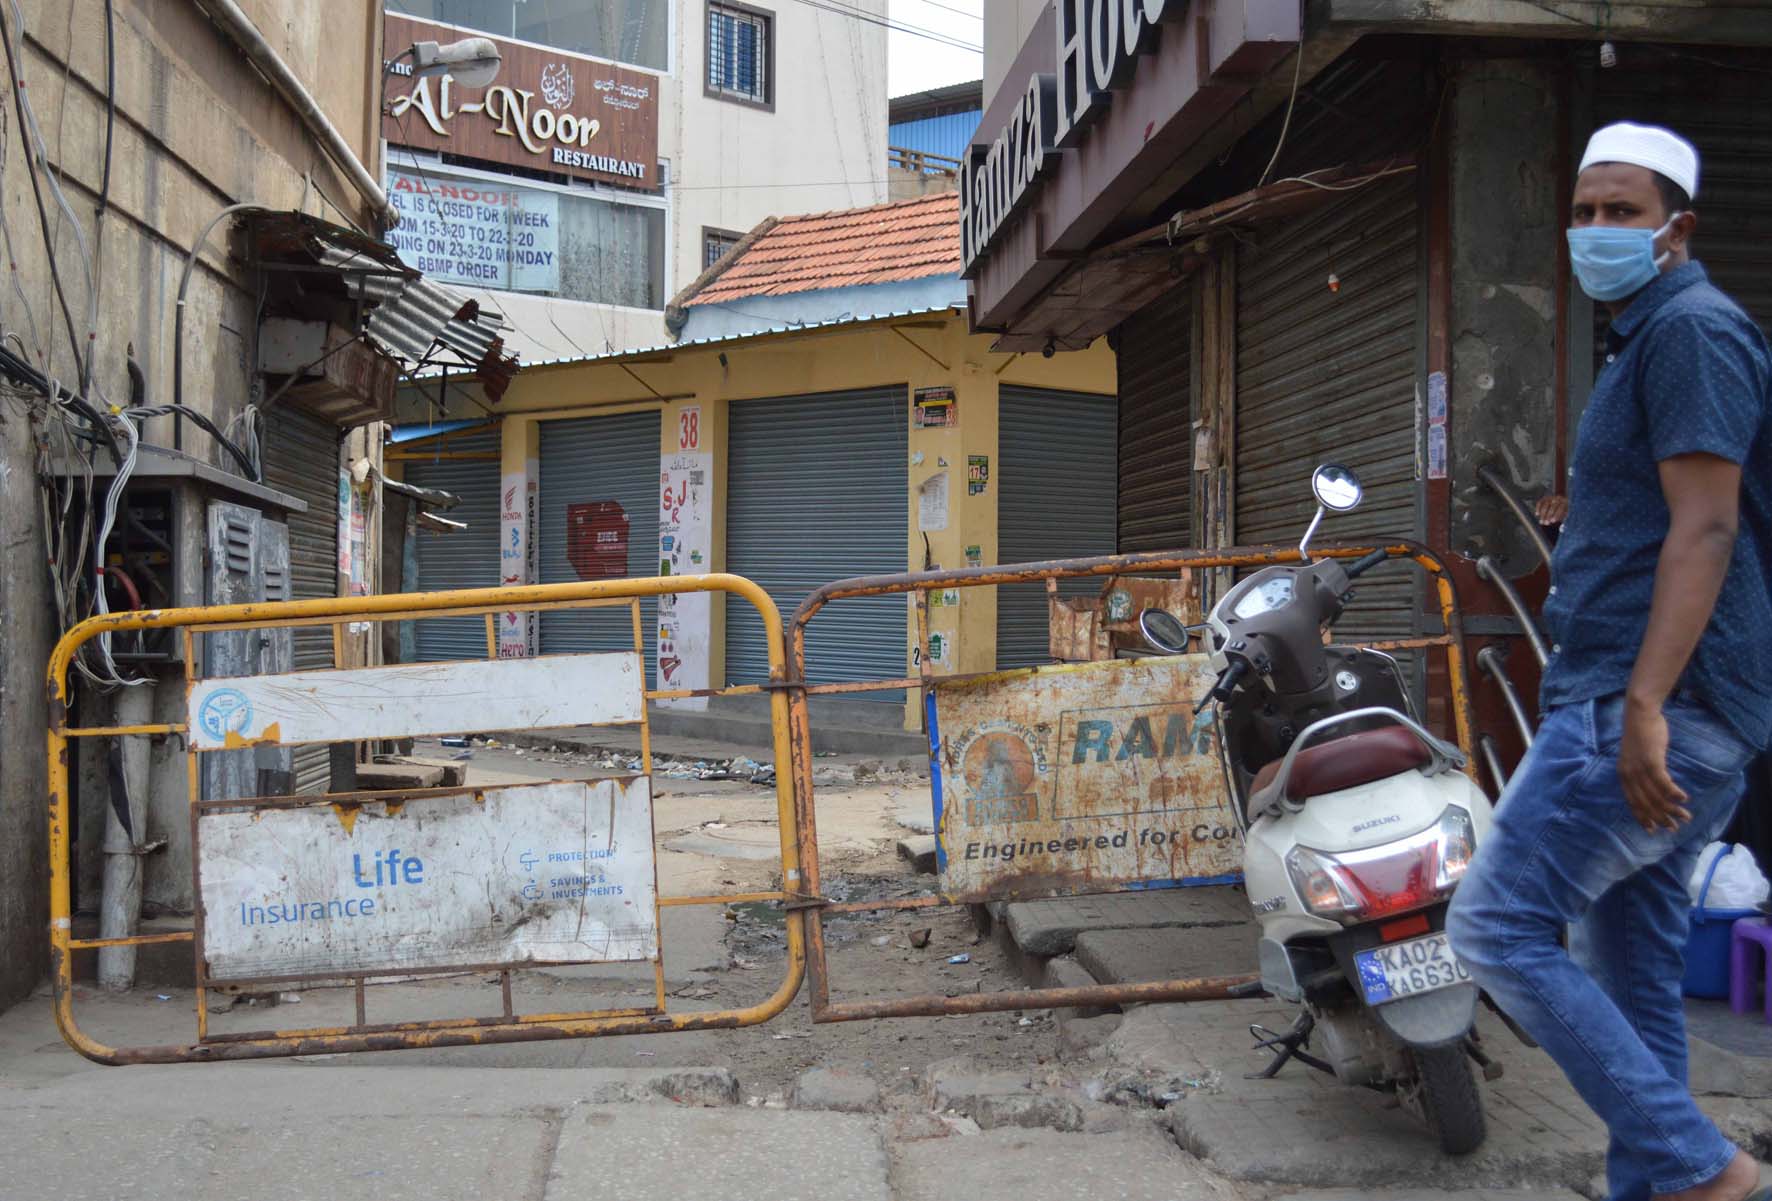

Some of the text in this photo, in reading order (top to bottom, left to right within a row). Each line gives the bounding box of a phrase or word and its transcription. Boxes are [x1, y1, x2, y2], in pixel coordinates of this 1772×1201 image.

[390, 74, 600, 154] Al-Noor
[553, 147, 645, 178] RESTAURANT
[959, 73, 1044, 280] Hamza
[387, 192, 549, 228] EL IS CLOSED FOR 1 WEEK
[469, 226, 485, 241] TO
[427, 239, 445, 255] ON
[449, 241, 493, 261] 23-3-20
[496, 248, 553, 266] MONDAY
[418, 256, 498, 280] BBMP ORDER
[680, 412, 698, 449] 38
[501, 642, 525, 658] Hero
[1352, 815, 1401, 833] SUZUKI
[548, 849, 613, 862] PROTECTION
[965, 831, 1128, 860] Engineered
[1140, 827, 1180, 846] for
[353, 848, 424, 888] Life
[550, 875, 597, 888] SAVINGS
[552, 886, 624, 899] INVESTMENTS
[241, 897, 376, 925] Insurance
[1381, 939, 1444, 971] KA02
[1368, 983, 1386, 993] IND
